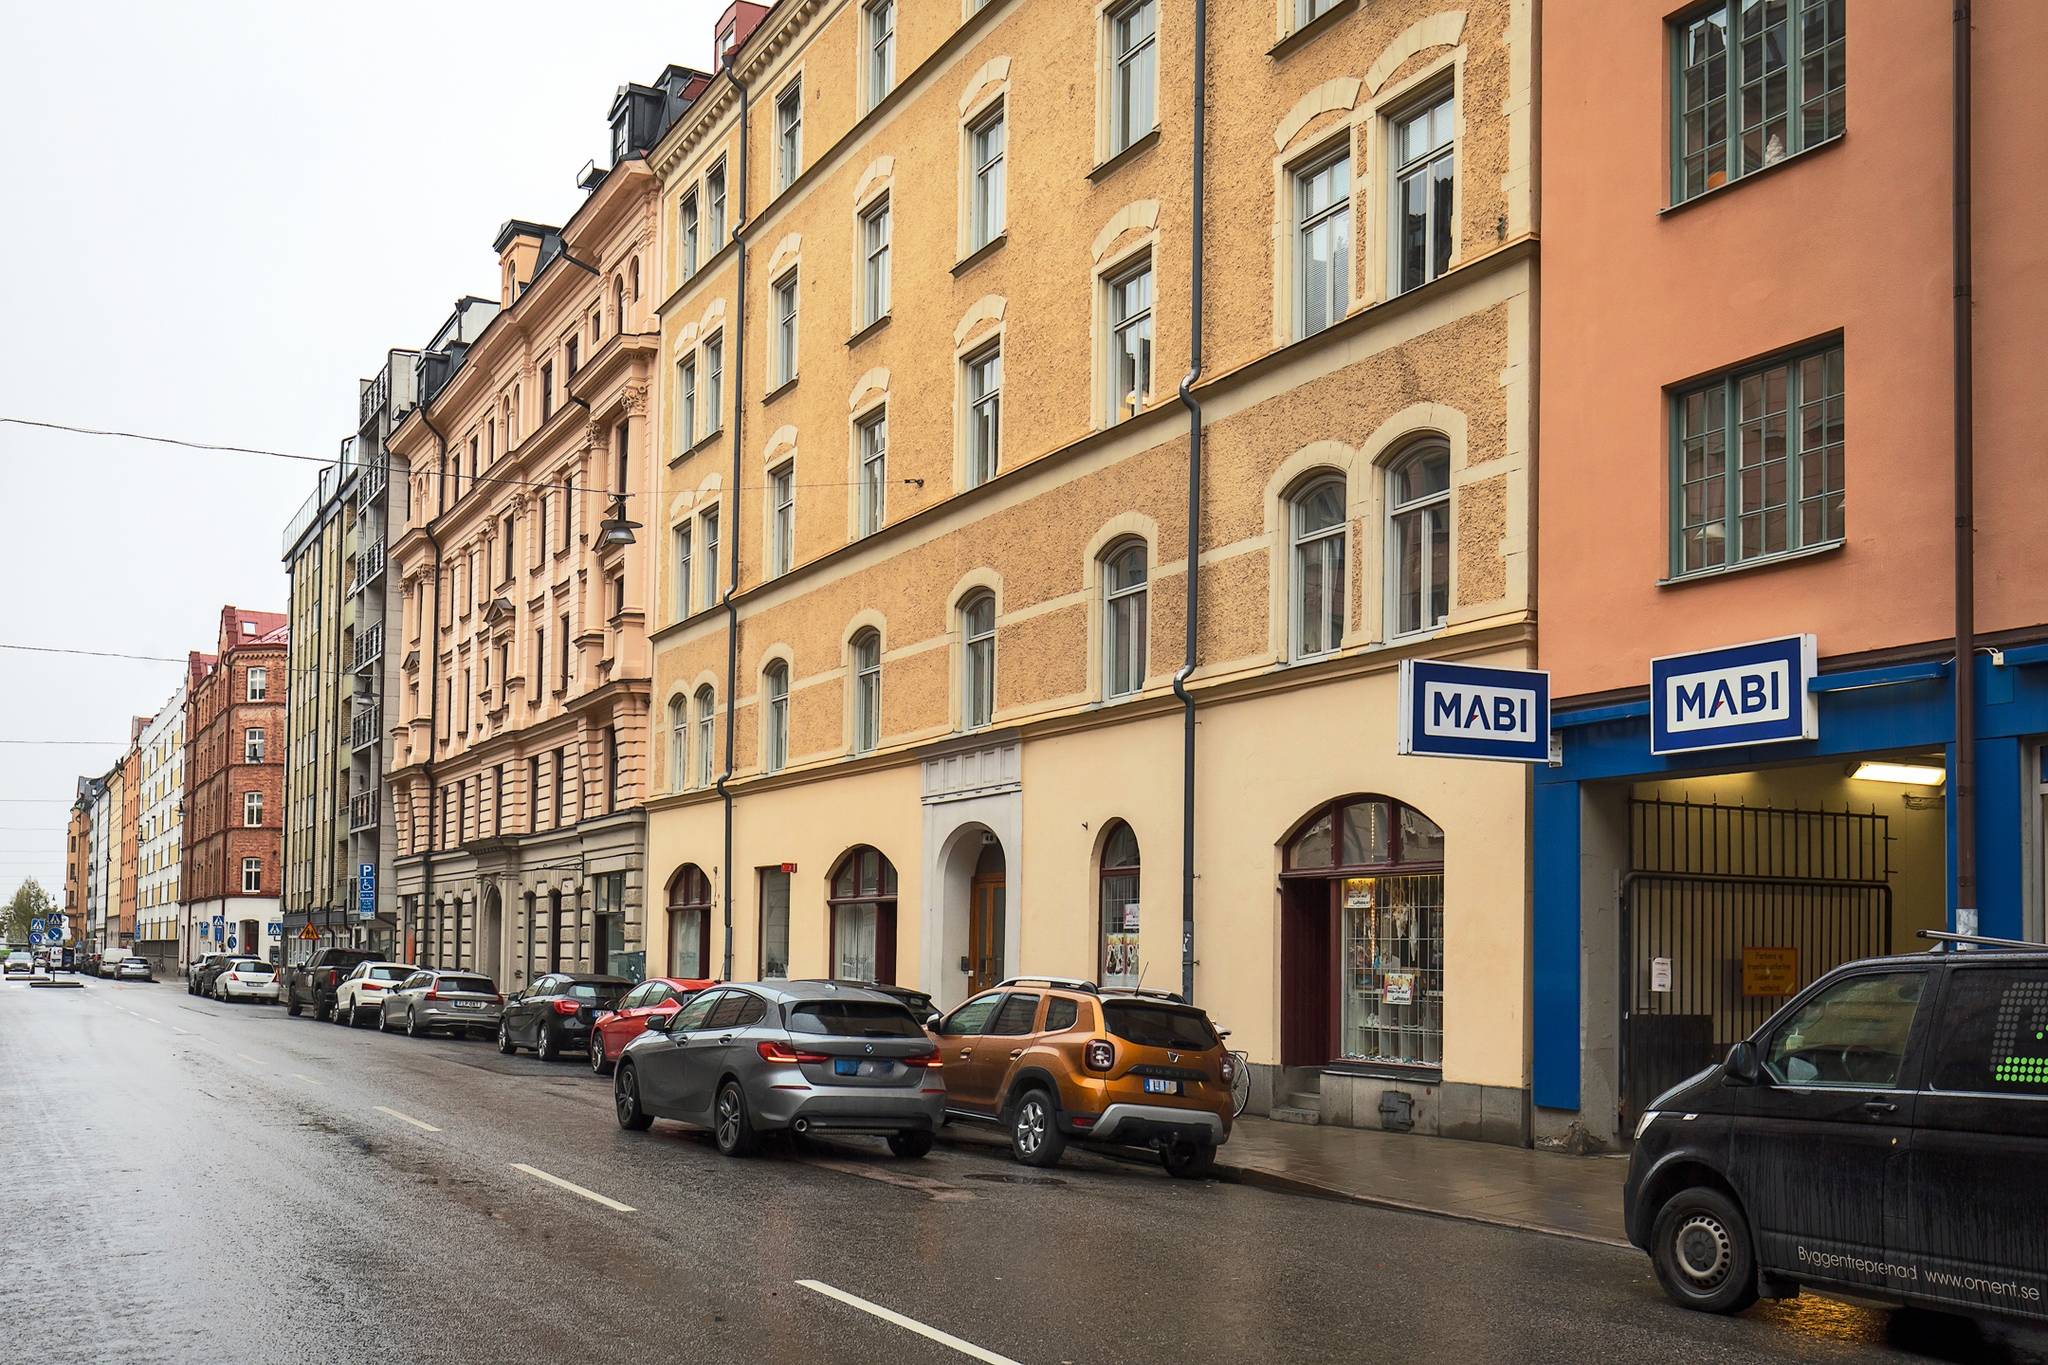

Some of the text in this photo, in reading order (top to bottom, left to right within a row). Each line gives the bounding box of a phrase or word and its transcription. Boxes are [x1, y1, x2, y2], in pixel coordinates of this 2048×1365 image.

[1433, 691, 1527, 733] MABI
[1676, 671, 1779, 722] MABI
[363, 865, 371, 876] P
[1798, 1246, 2041, 1301] Byggentreprenad www.oment.se
